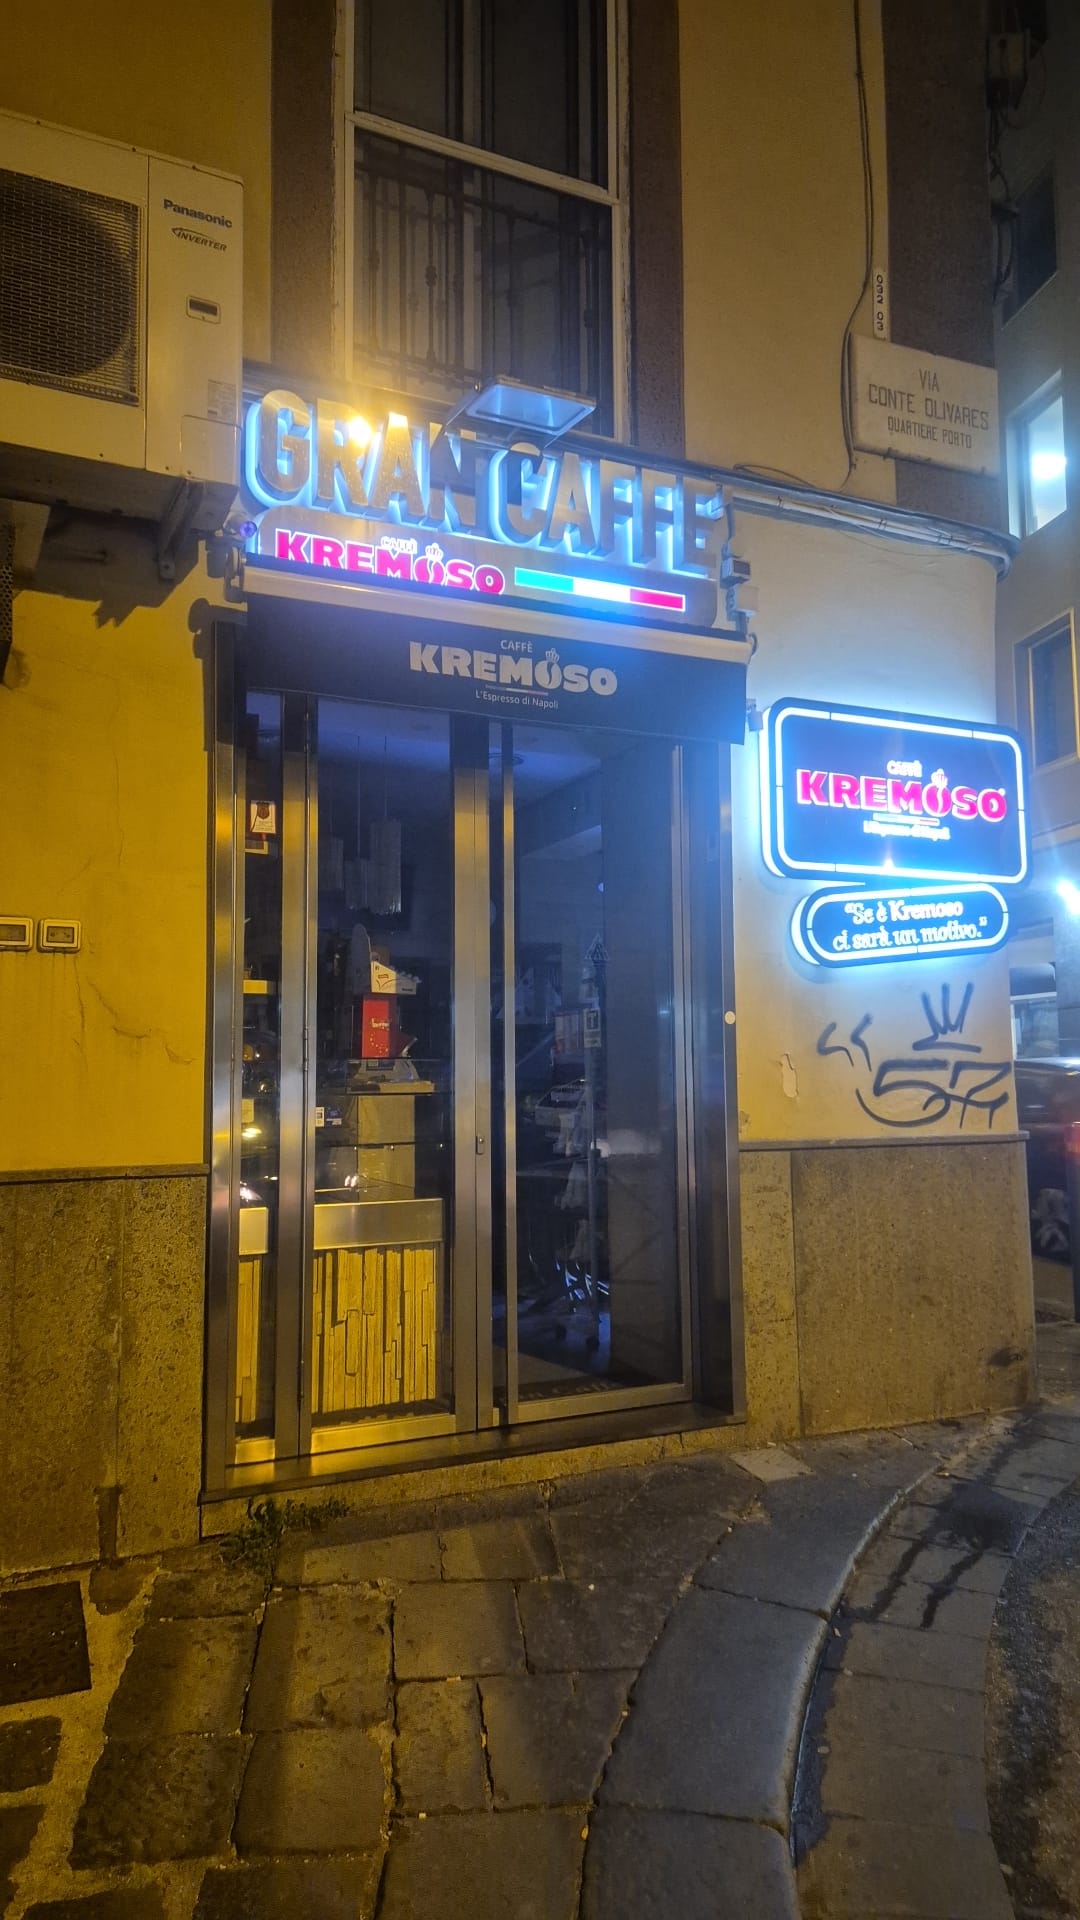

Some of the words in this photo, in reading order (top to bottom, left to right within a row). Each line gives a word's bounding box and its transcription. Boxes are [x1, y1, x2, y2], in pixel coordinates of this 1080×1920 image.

[163, 198, 233, 228] Panasonic
[177, 231, 228, 252] INVERTER
[918, 368, 940, 393] VIA
[868, 383, 916, 414] CONTE
[924, 398, 990, 431] OLIVARES
[887, 416, 938, 442] QUARTIERE
[942, 429, 972, 449] PORTO
[250, 390, 477, 530] GRAN
[275, 528, 505, 596] KREMOSO
[500, 639, 533, 653] CAFFÈ
[409, 640, 618, 696] KREMOSO
[475, 689, 520, 704] L'Espresso
[521, 696, 530, 705] di
[532, 698, 559, 709] Napoli
[796, 768, 1008, 823] KREMOSO
[888, 899, 964, 922] Kremoso
[892, 928, 920, 946] un
